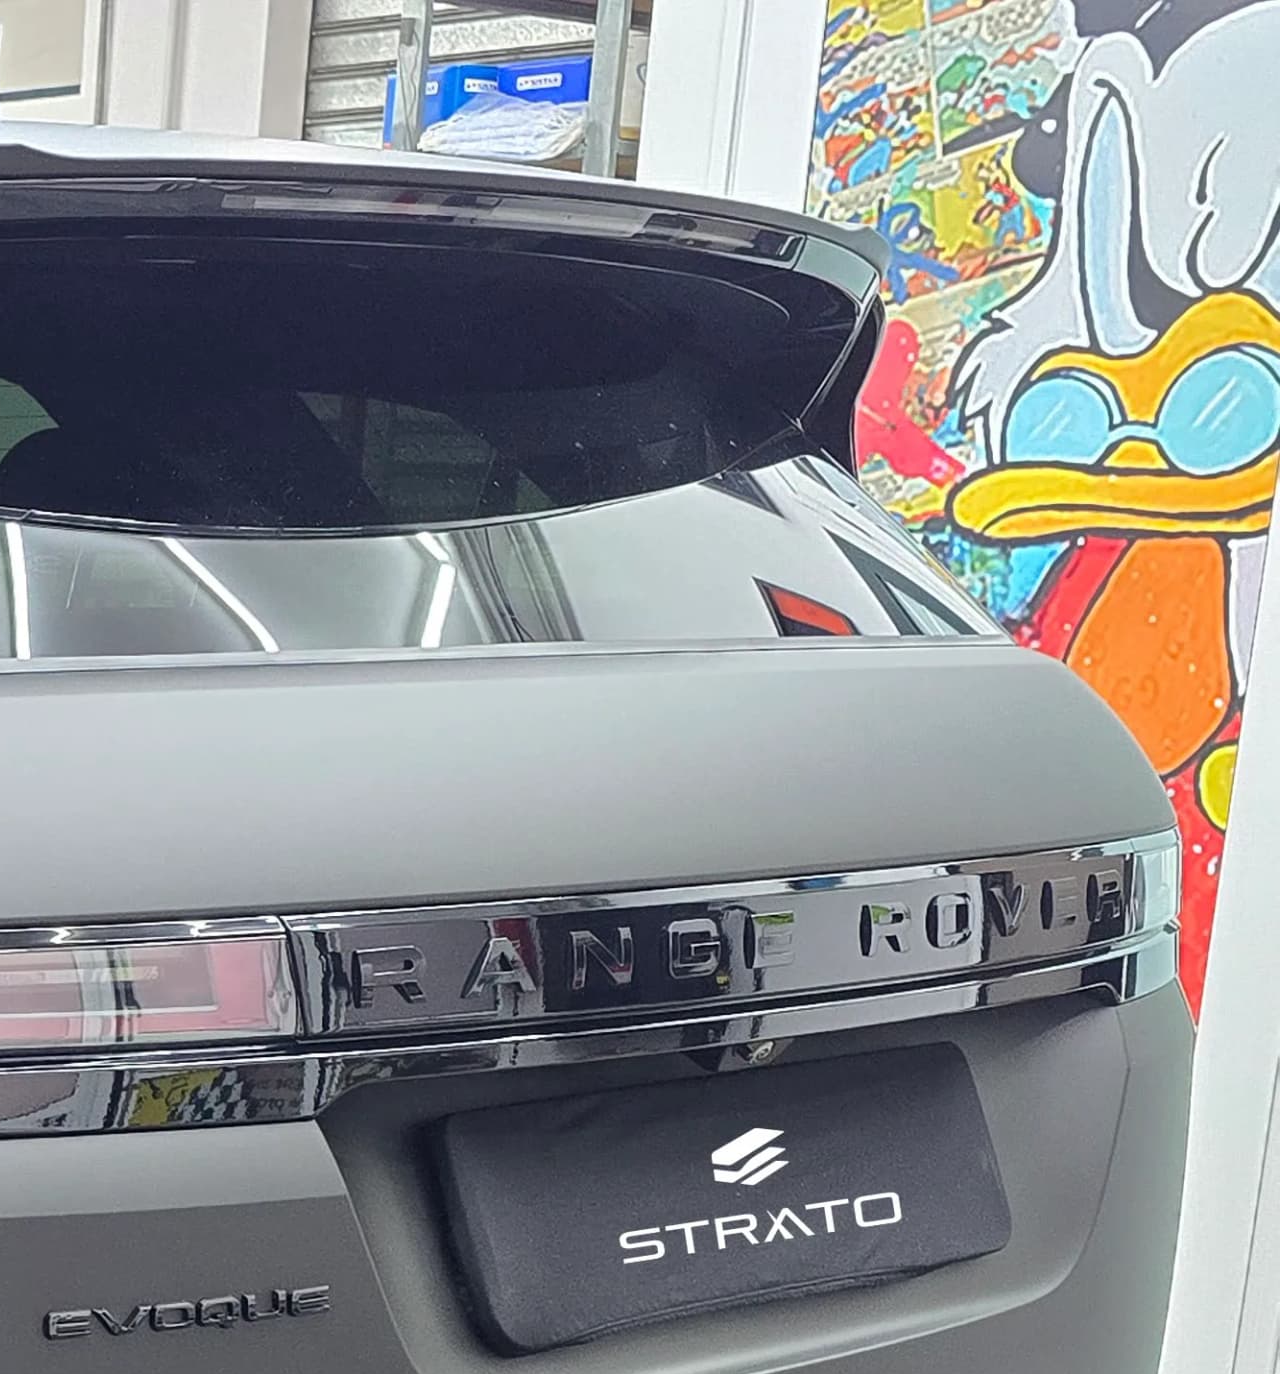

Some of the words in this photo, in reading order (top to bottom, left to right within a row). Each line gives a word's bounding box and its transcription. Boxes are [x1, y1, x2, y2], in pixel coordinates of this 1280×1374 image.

[351, 913, 796, 1007] RANGE
[858, 868, 1124, 957] ROVER
[618, 1192, 903, 1265] STRATO
[43, 1284, 331, 1340] EVOQUE
